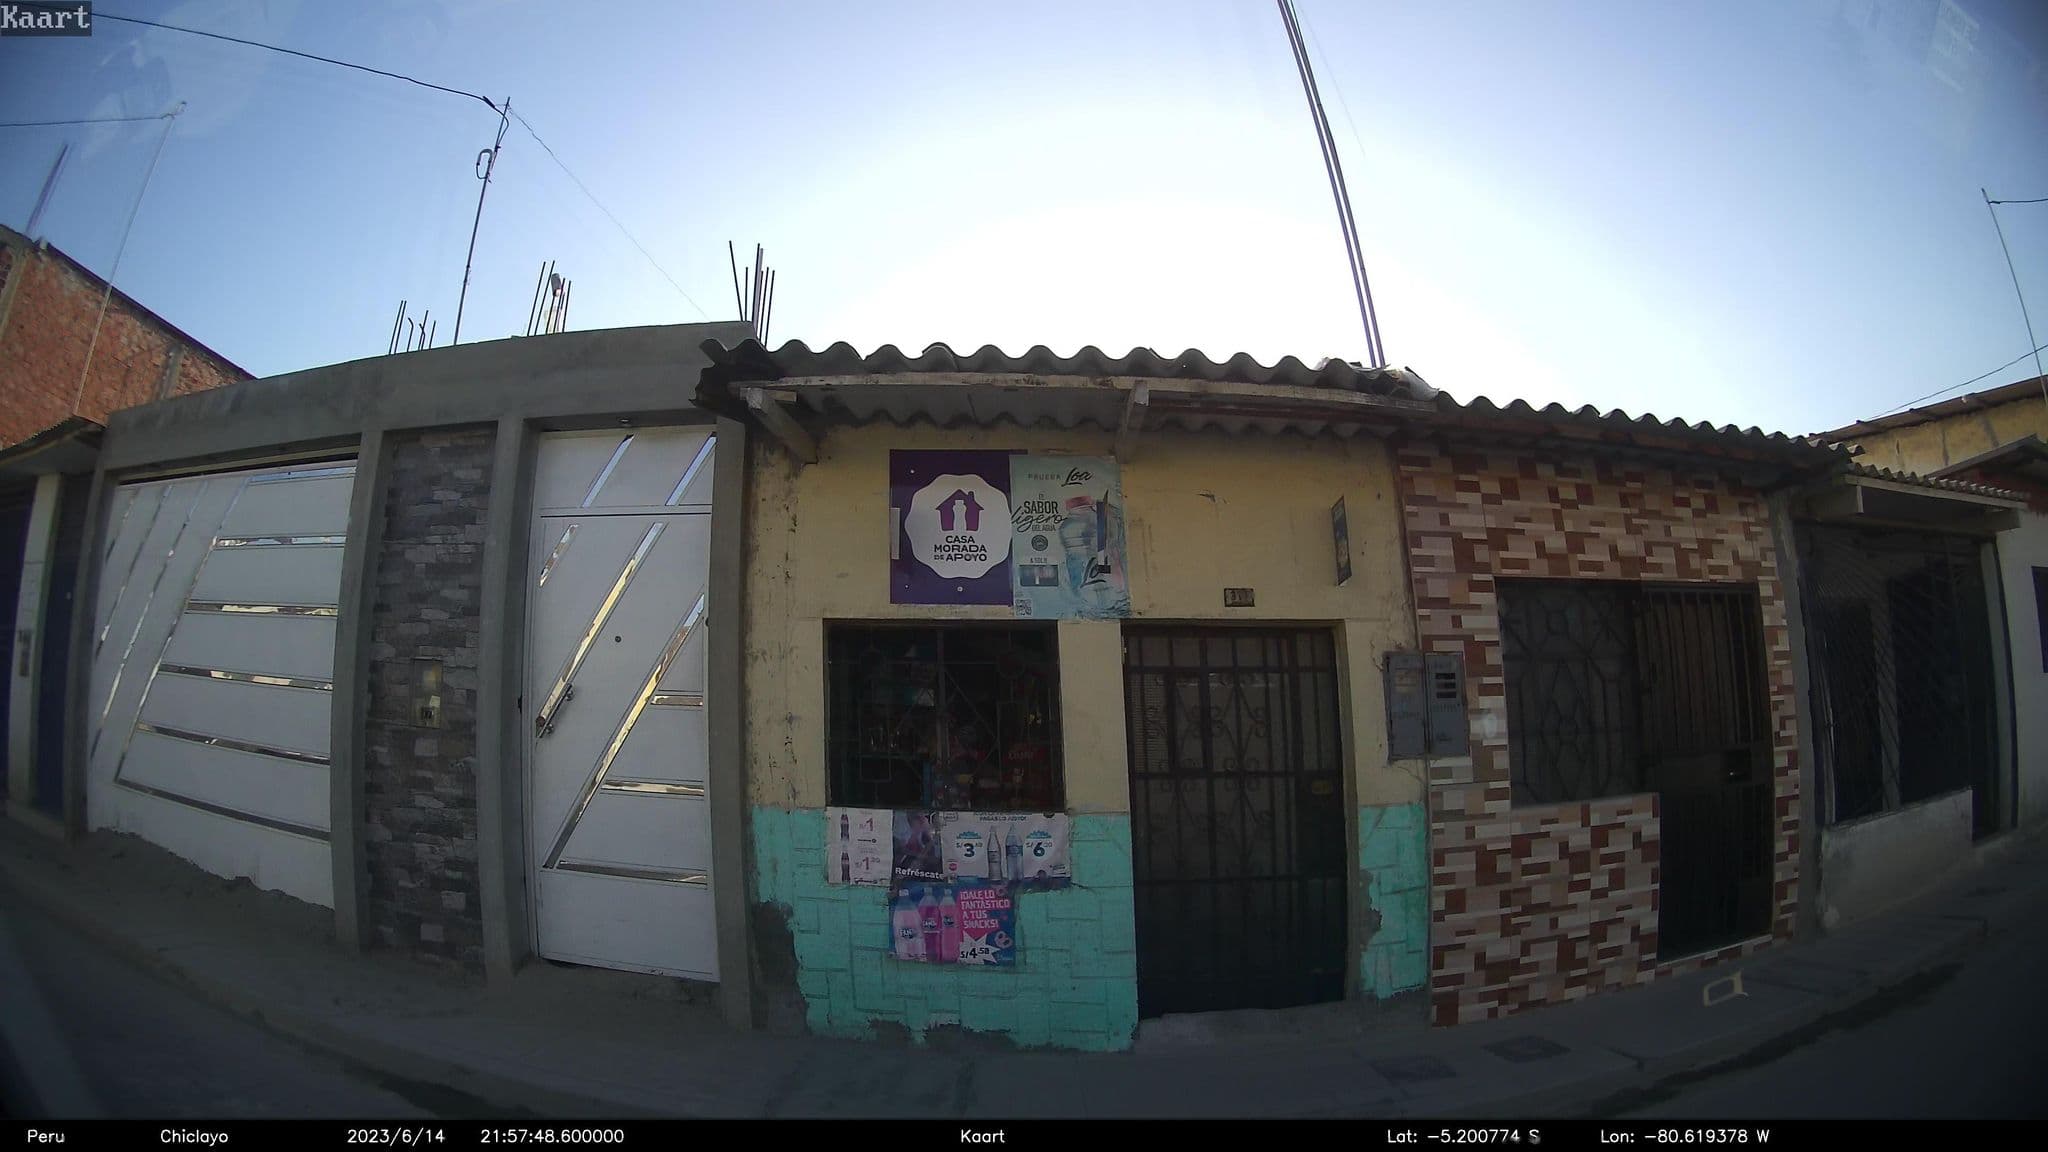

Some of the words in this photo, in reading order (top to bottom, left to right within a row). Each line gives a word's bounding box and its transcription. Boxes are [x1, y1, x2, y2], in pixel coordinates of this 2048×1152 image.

[1028, 473, 1061, 481] PRUEBA
[1061, 467, 1093, 487] Loa
[1023, 500, 1059, 514] SABOR
[945, 535, 976, 544] CASA
[934, 544, 988, 553] MORADA
[945, 553, 988, 562] APOYO
[984, 889, 995, 899] LO
[963, 911, 970, 920] A
[970, 909, 987, 919] TUS
